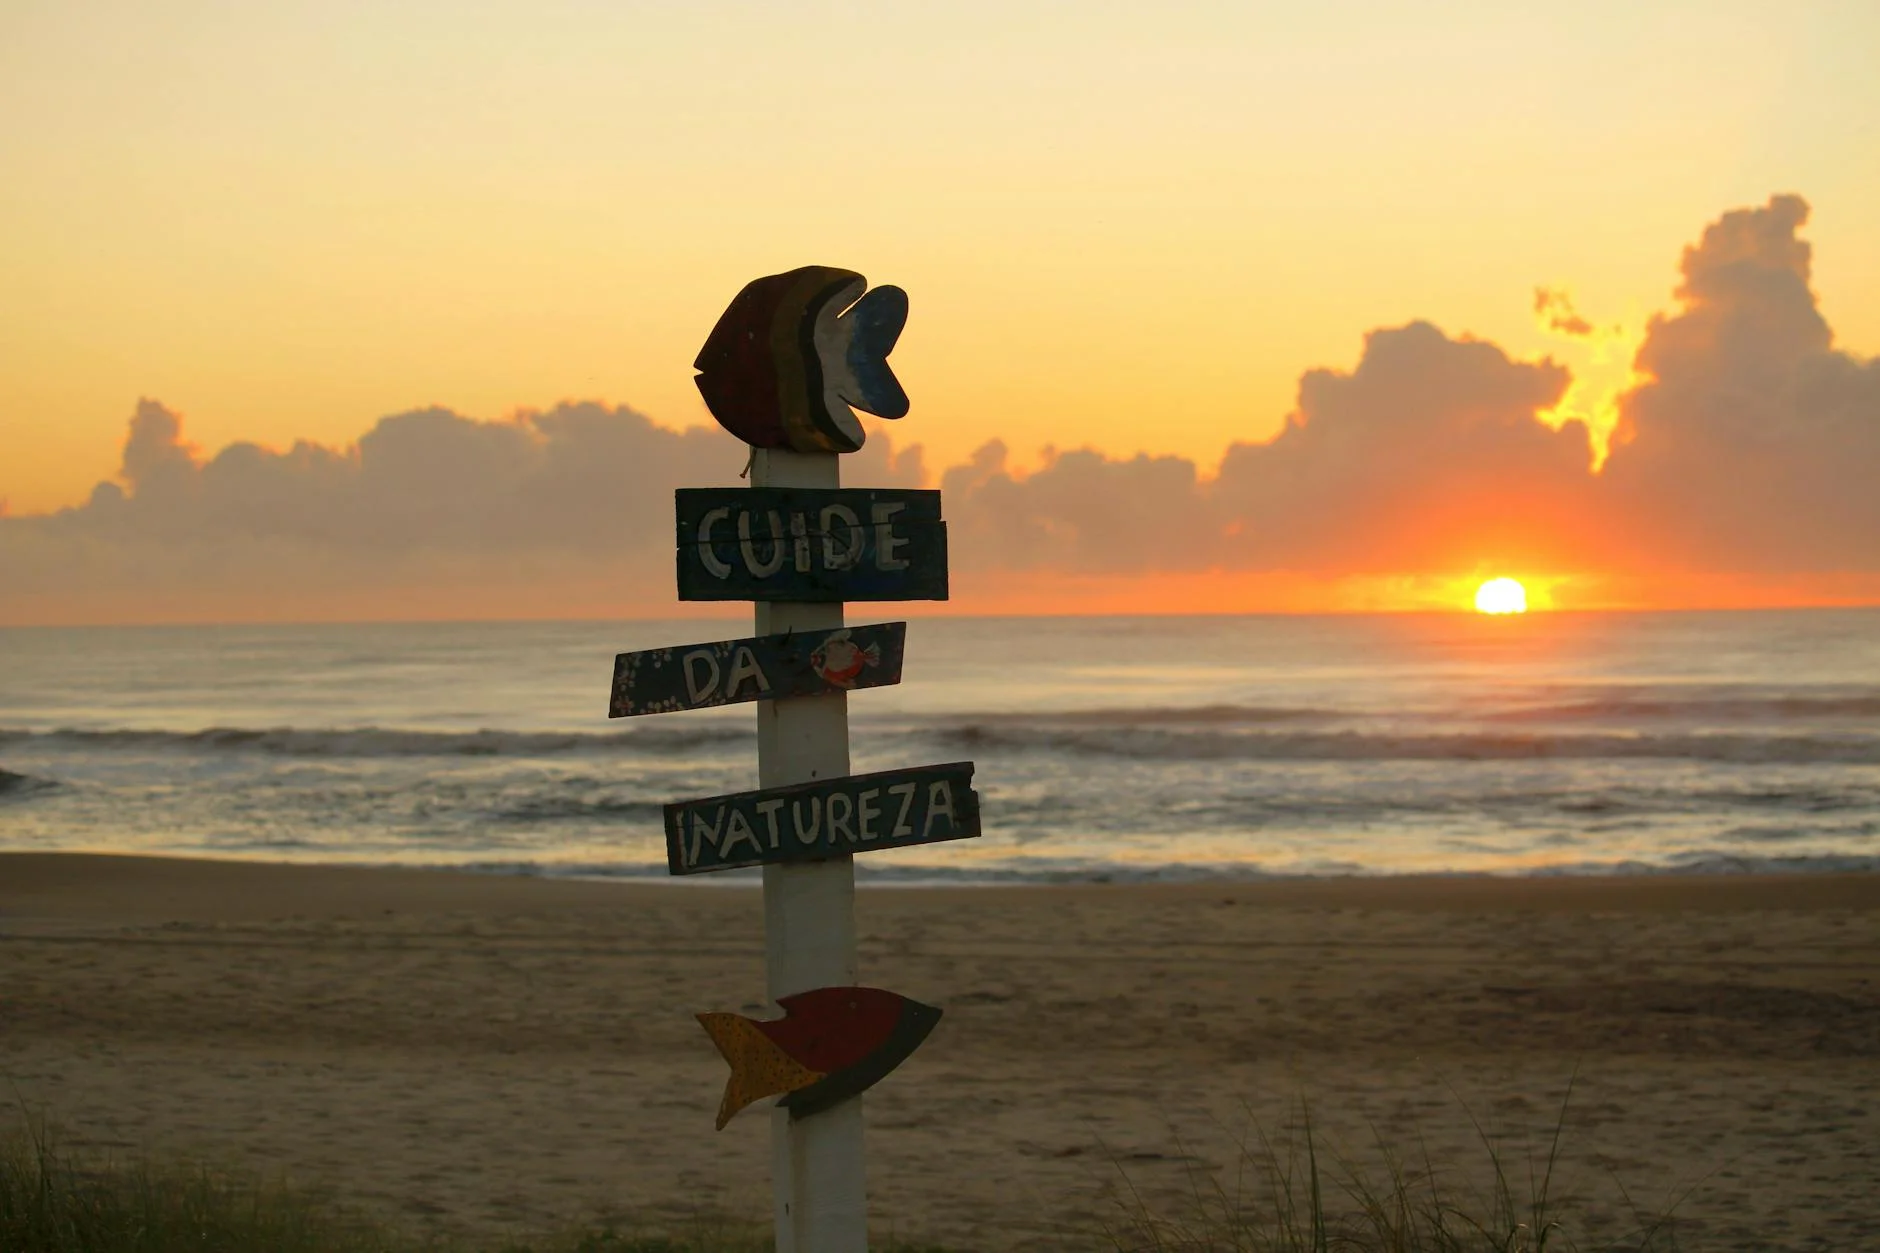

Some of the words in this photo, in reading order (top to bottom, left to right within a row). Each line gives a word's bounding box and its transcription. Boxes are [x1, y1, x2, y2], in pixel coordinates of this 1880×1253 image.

[697, 502, 910, 579] CUIDE
[682, 646, 771, 705] DA
[687, 781, 957, 867] NATUREZA
